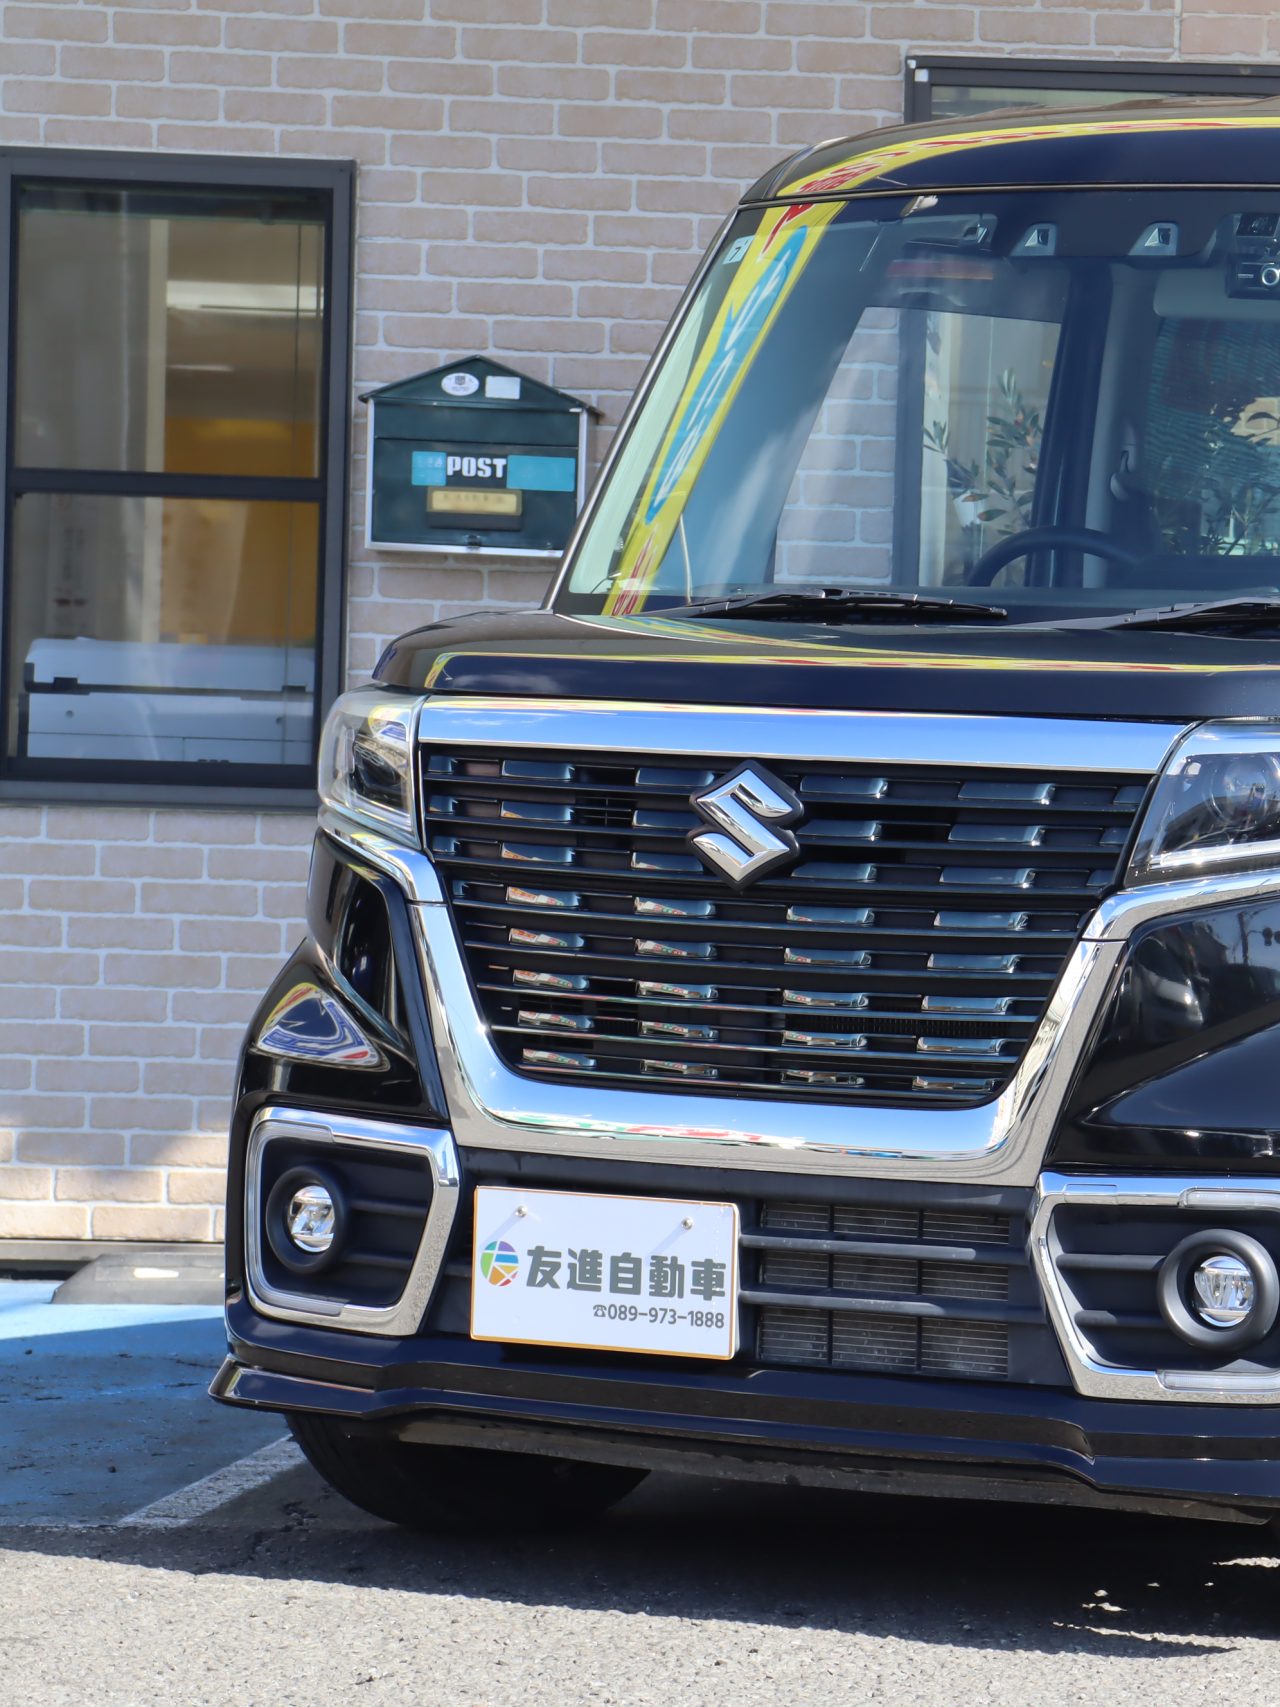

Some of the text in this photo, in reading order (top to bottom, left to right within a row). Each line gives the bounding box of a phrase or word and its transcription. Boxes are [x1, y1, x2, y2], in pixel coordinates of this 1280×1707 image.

[447, 456, 507, 478] POST
[526, 1245, 727, 1301] 友進自動車
[607, 1304, 725, 1329] 089-973-1888
